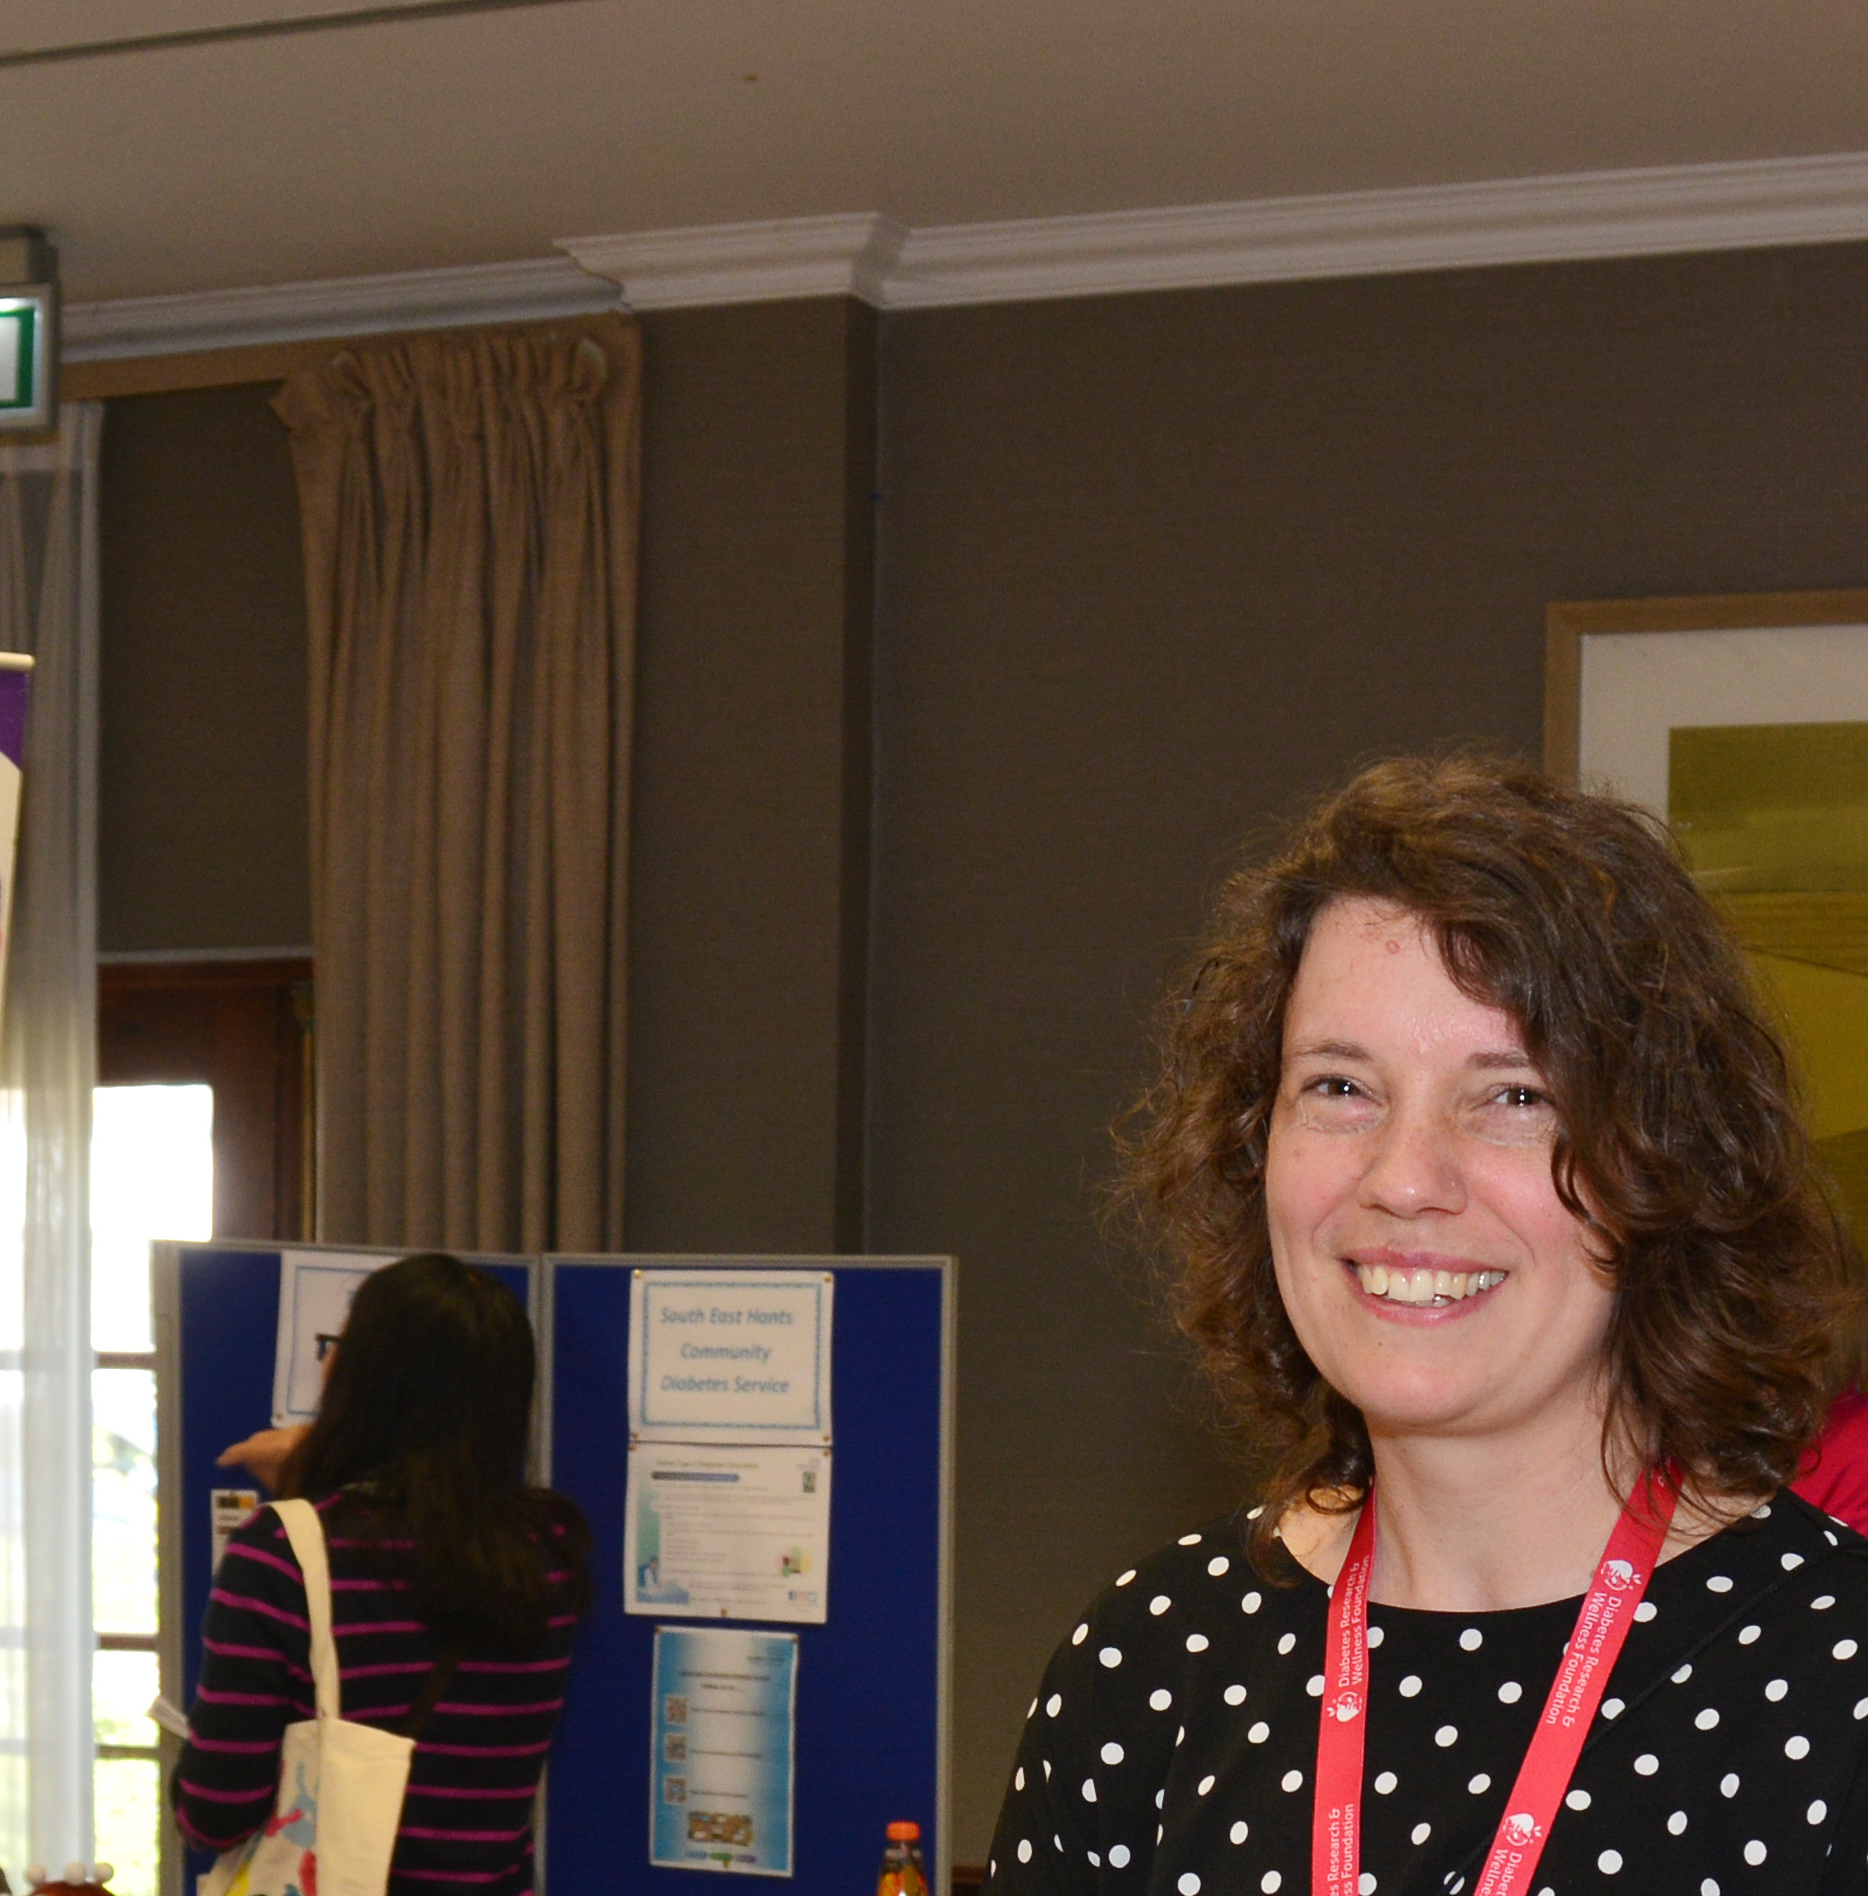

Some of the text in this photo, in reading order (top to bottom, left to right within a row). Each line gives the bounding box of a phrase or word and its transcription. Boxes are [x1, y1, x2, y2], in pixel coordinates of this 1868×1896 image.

[659, 1306, 794, 1326] South East Hants
[681, 1342, 772, 1363] Community
[660, 1374, 791, 1394] Diabetes Service
[1340, 1574, 1357, 1628] Research
[1352, 1555, 1370, 1685] Wellness Foundation
[1339, 1630, 1350, 1687] Diabetes
[1546, 1591, 1607, 1724] Wellness Foundation
[1562, 1595, 1622, 1727] Diabetes Research &
[1329, 1808, 1340, 1819] &
[1341, 1803, 1354, 1879] Foundation
[1327, 1821, 1340, 1882] Research
